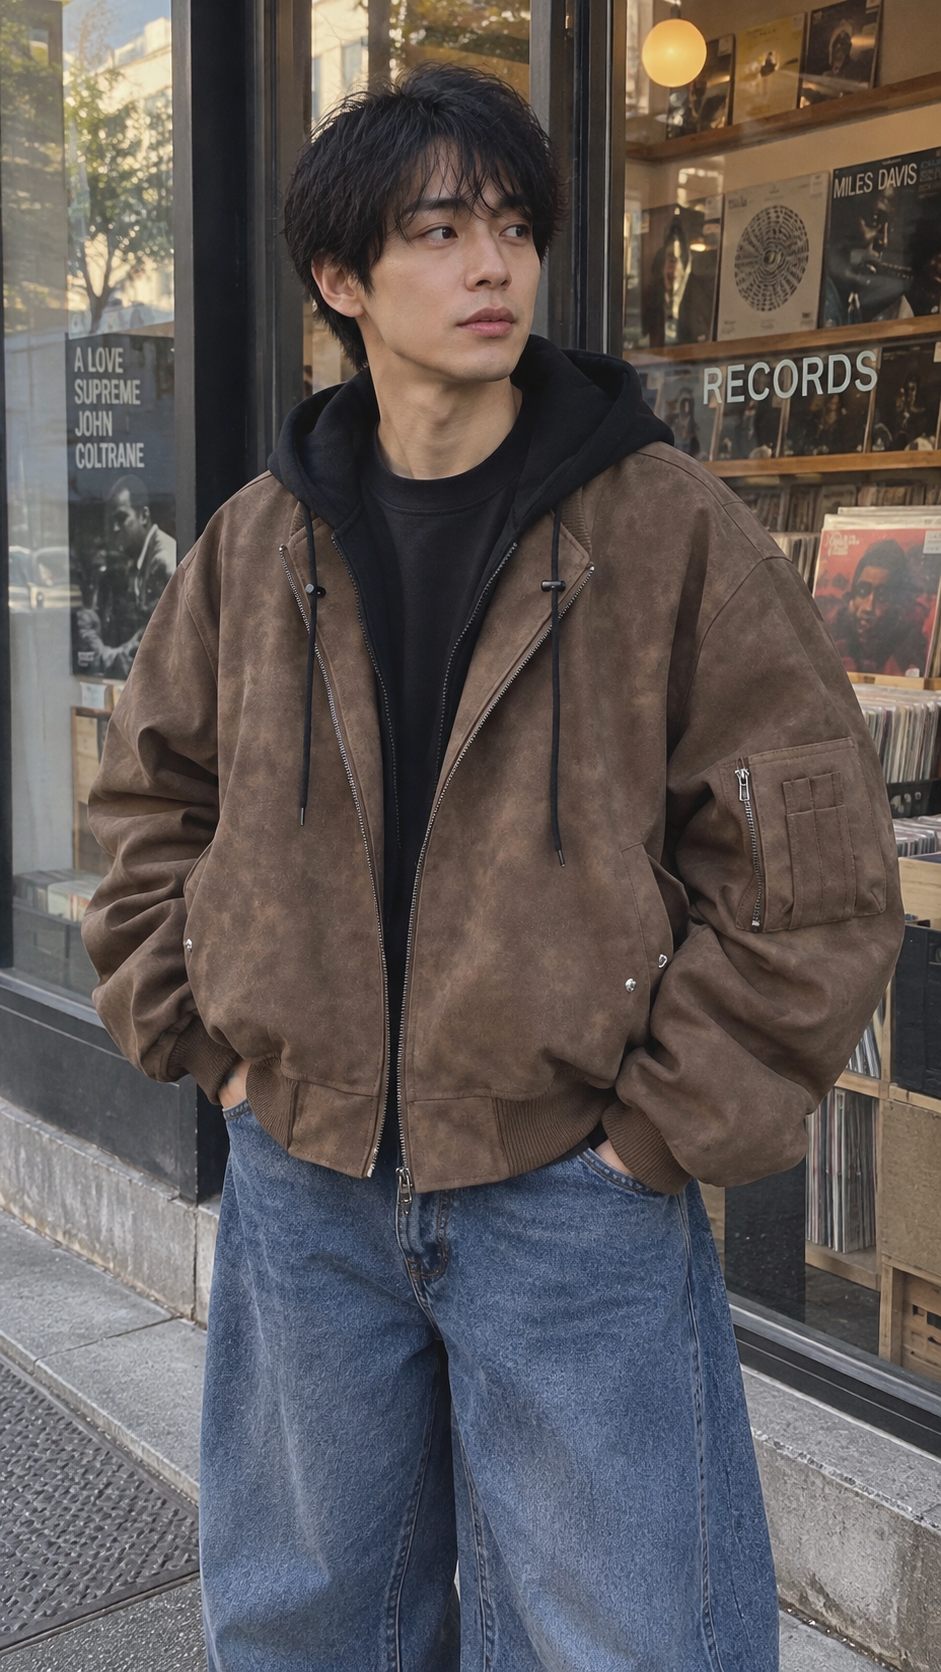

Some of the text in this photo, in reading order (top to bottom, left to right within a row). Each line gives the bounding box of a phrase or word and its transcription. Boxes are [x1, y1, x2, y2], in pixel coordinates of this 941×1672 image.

[833, 172, 873, 199] MILES
[878, 163, 918, 190] DAVIS
[74, 347, 124, 373] A LOVE
[703, 350, 878, 405] RECORDS
[74, 379, 141, 405] SUPREME
[75, 411, 113, 437] JOHN
[76, 442, 145, 469] COLTRANE
